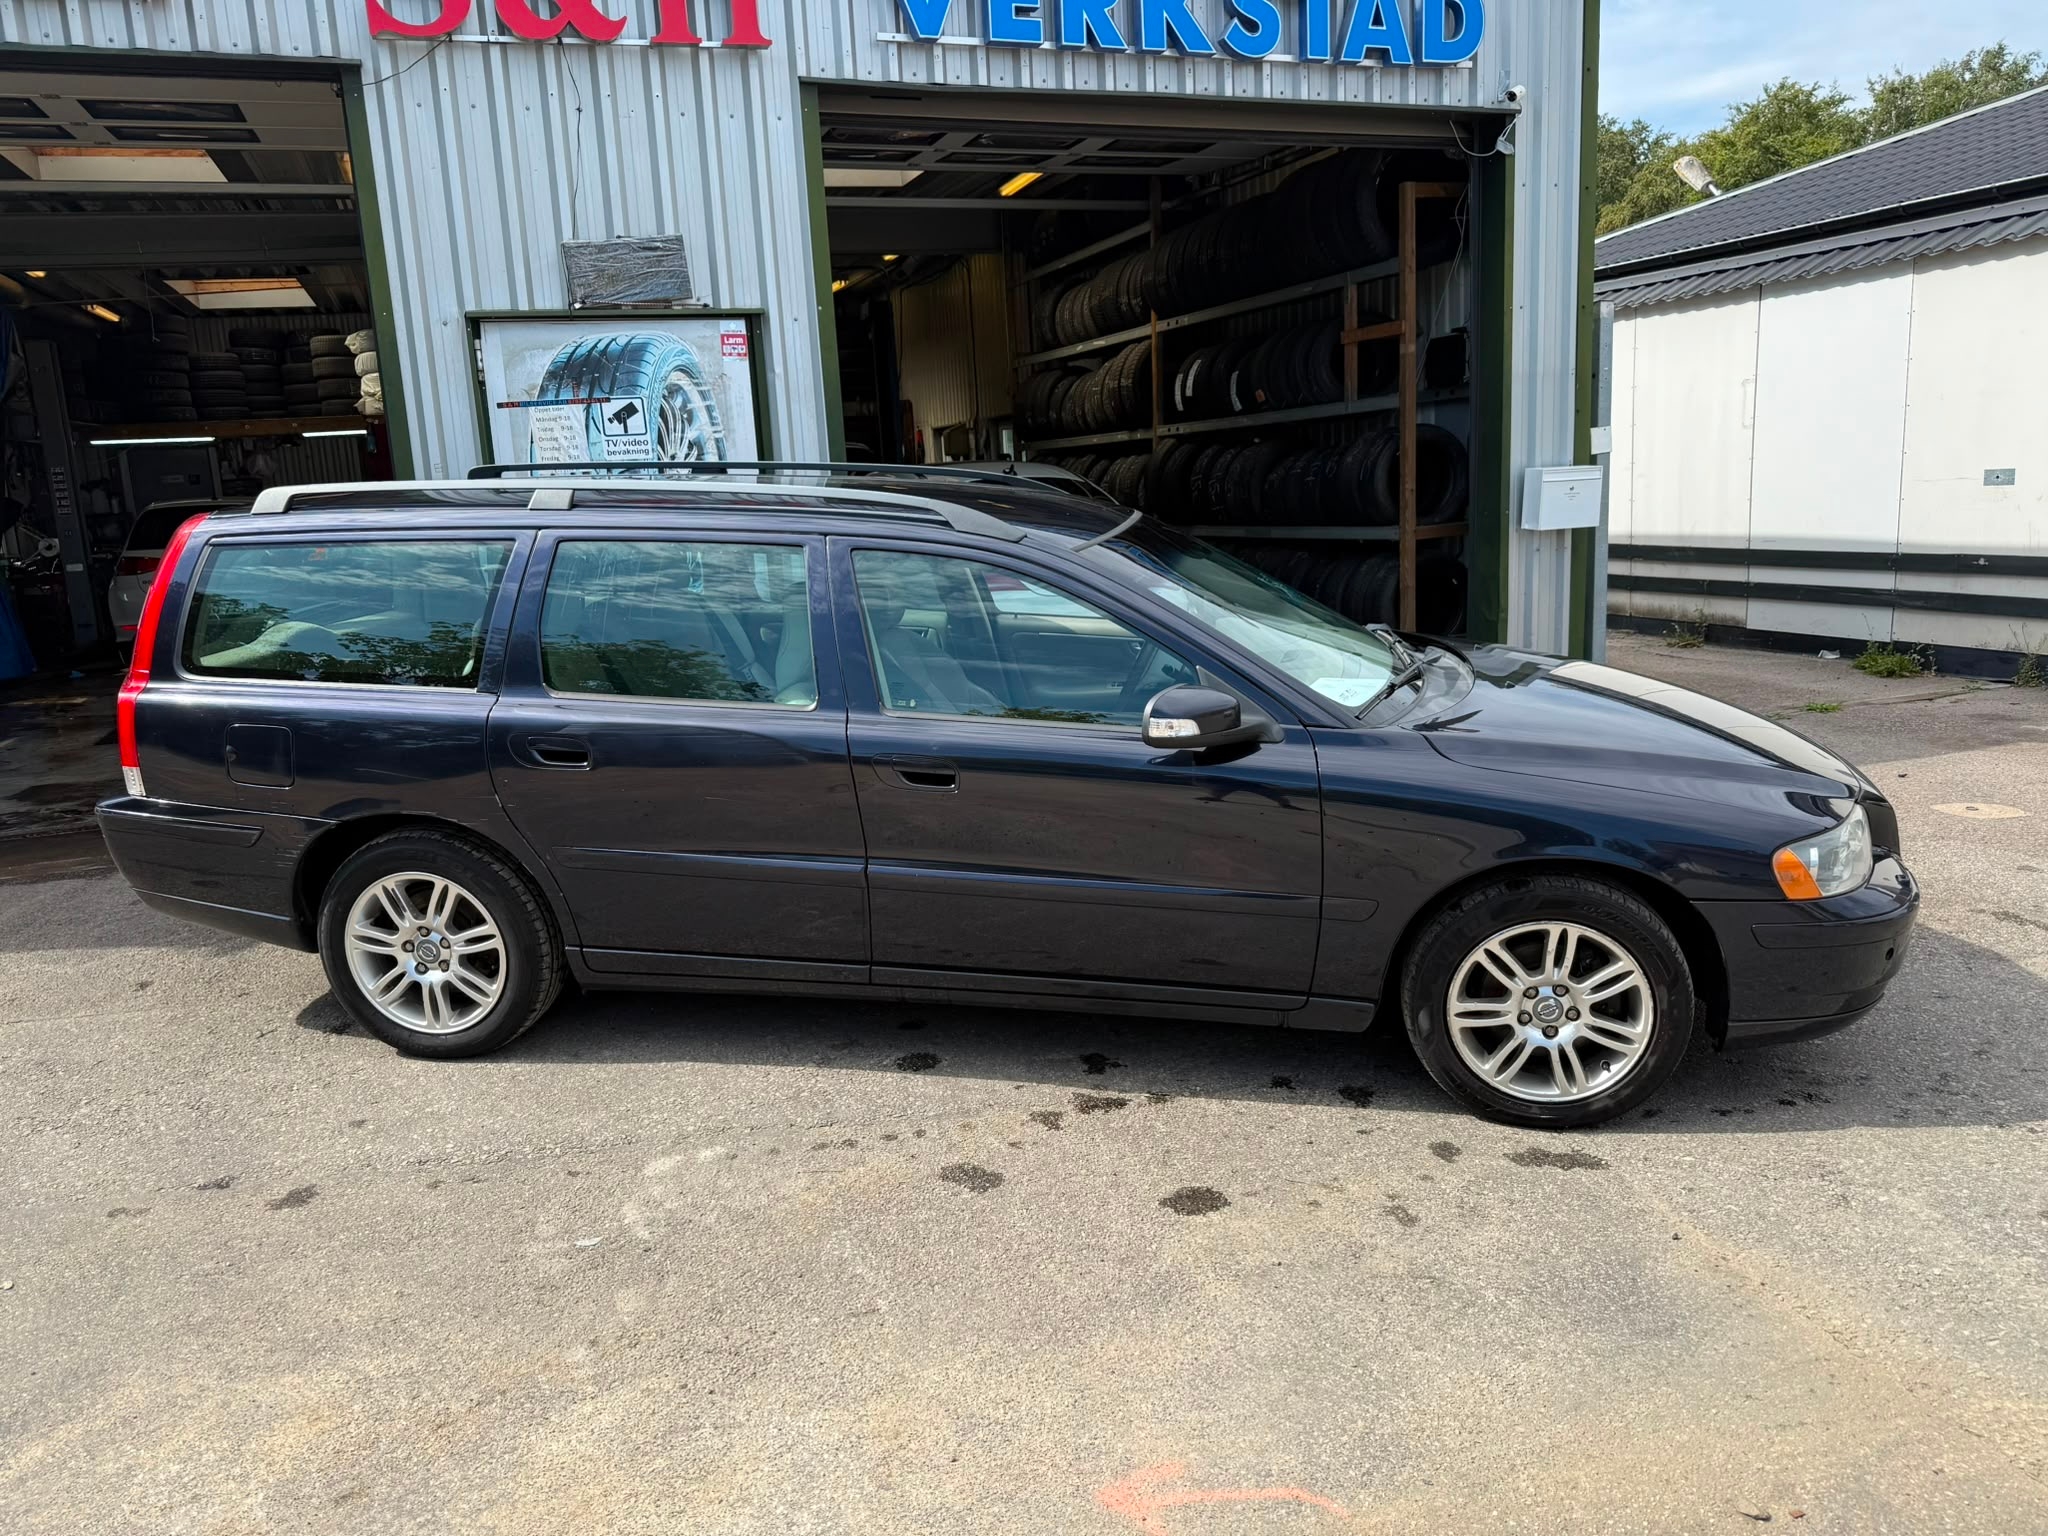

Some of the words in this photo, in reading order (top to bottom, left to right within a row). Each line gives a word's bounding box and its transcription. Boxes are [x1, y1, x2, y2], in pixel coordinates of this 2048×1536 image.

[724, 336, 744, 344] Larm
[605, 438, 649, 448] TV/video
[607, 447, 650, 456] bevakning
